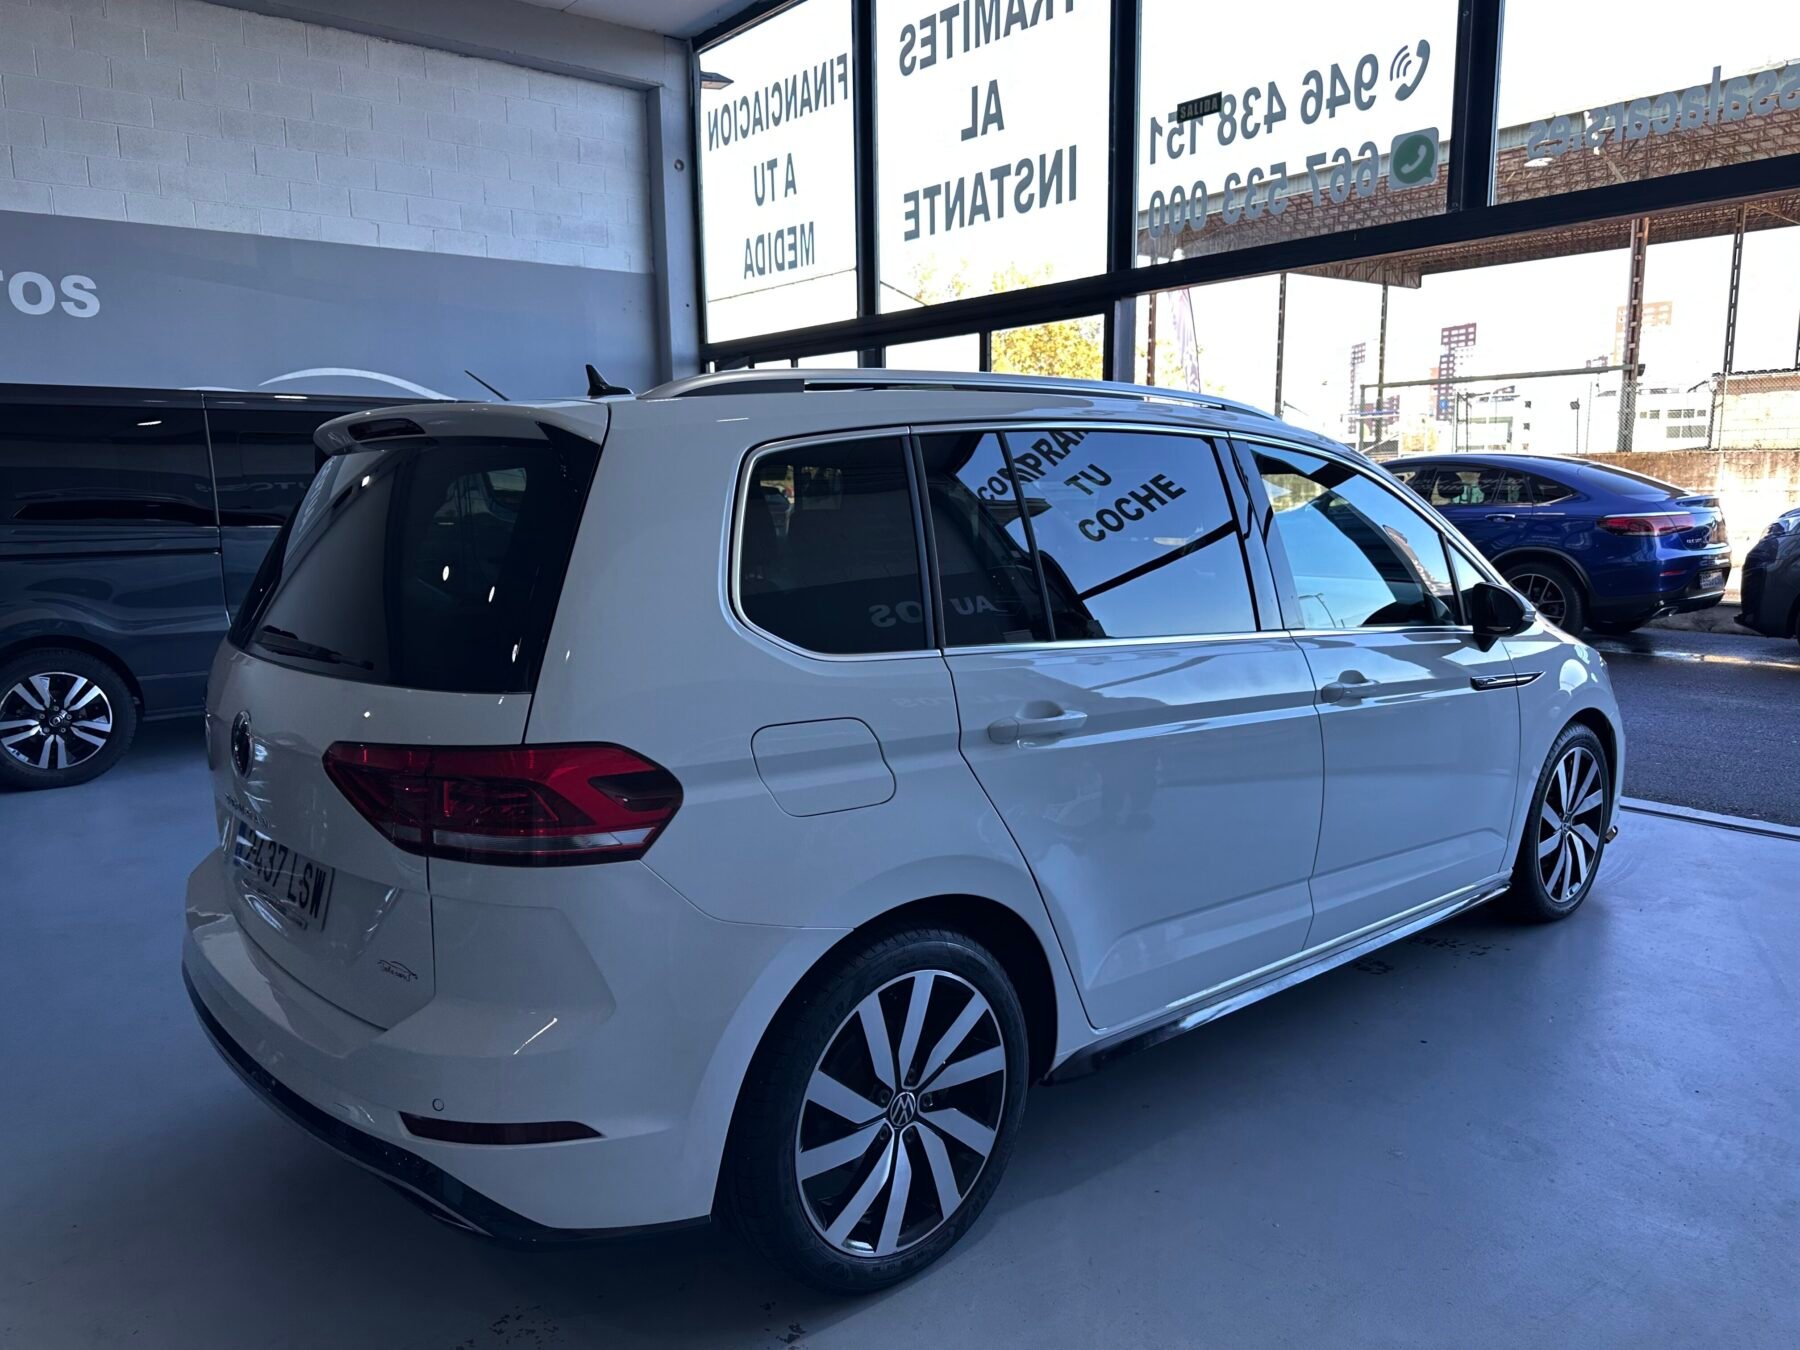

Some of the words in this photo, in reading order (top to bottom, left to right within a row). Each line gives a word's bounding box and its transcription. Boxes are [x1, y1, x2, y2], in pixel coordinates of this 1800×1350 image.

[1179, 96, 1219, 120] SALIDA
[0, 270, 100, 318] OS
[1063, 463, 1112, 496] TU
[1078, 473, 1187, 542] COCHE
[287, 852, 327, 920] LSW
